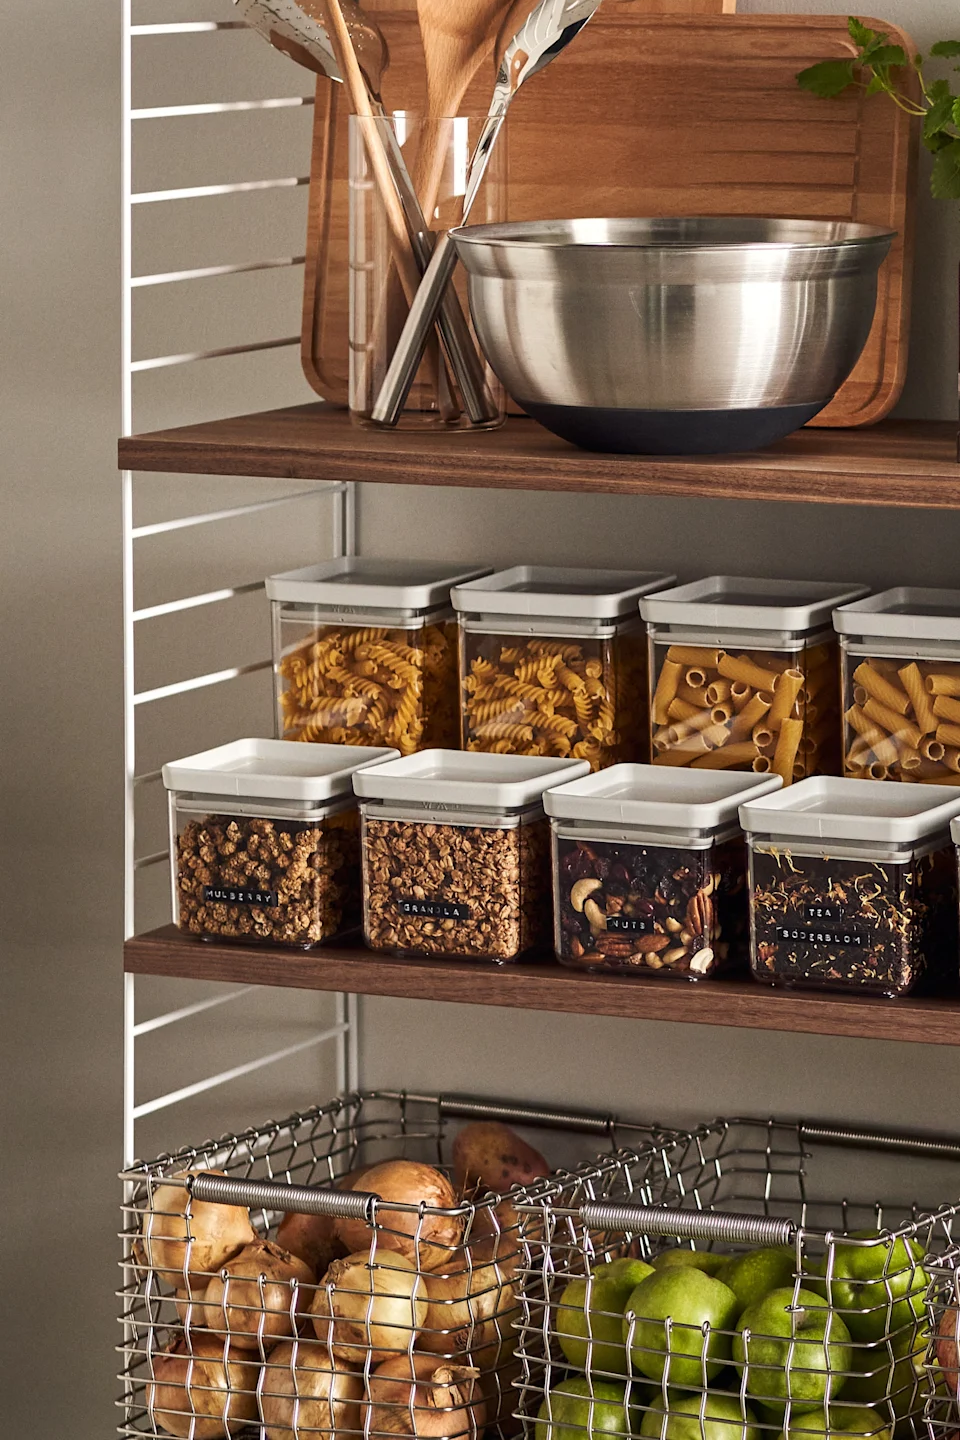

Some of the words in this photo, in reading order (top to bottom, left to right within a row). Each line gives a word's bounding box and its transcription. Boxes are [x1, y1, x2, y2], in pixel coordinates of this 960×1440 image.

[205, 890, 271, 902] MULBERRY
[403, 903, 460, 916] GRANOLA
[808, 908, 832, 918] TEA
[611, 920, 646, 930] NUTS
